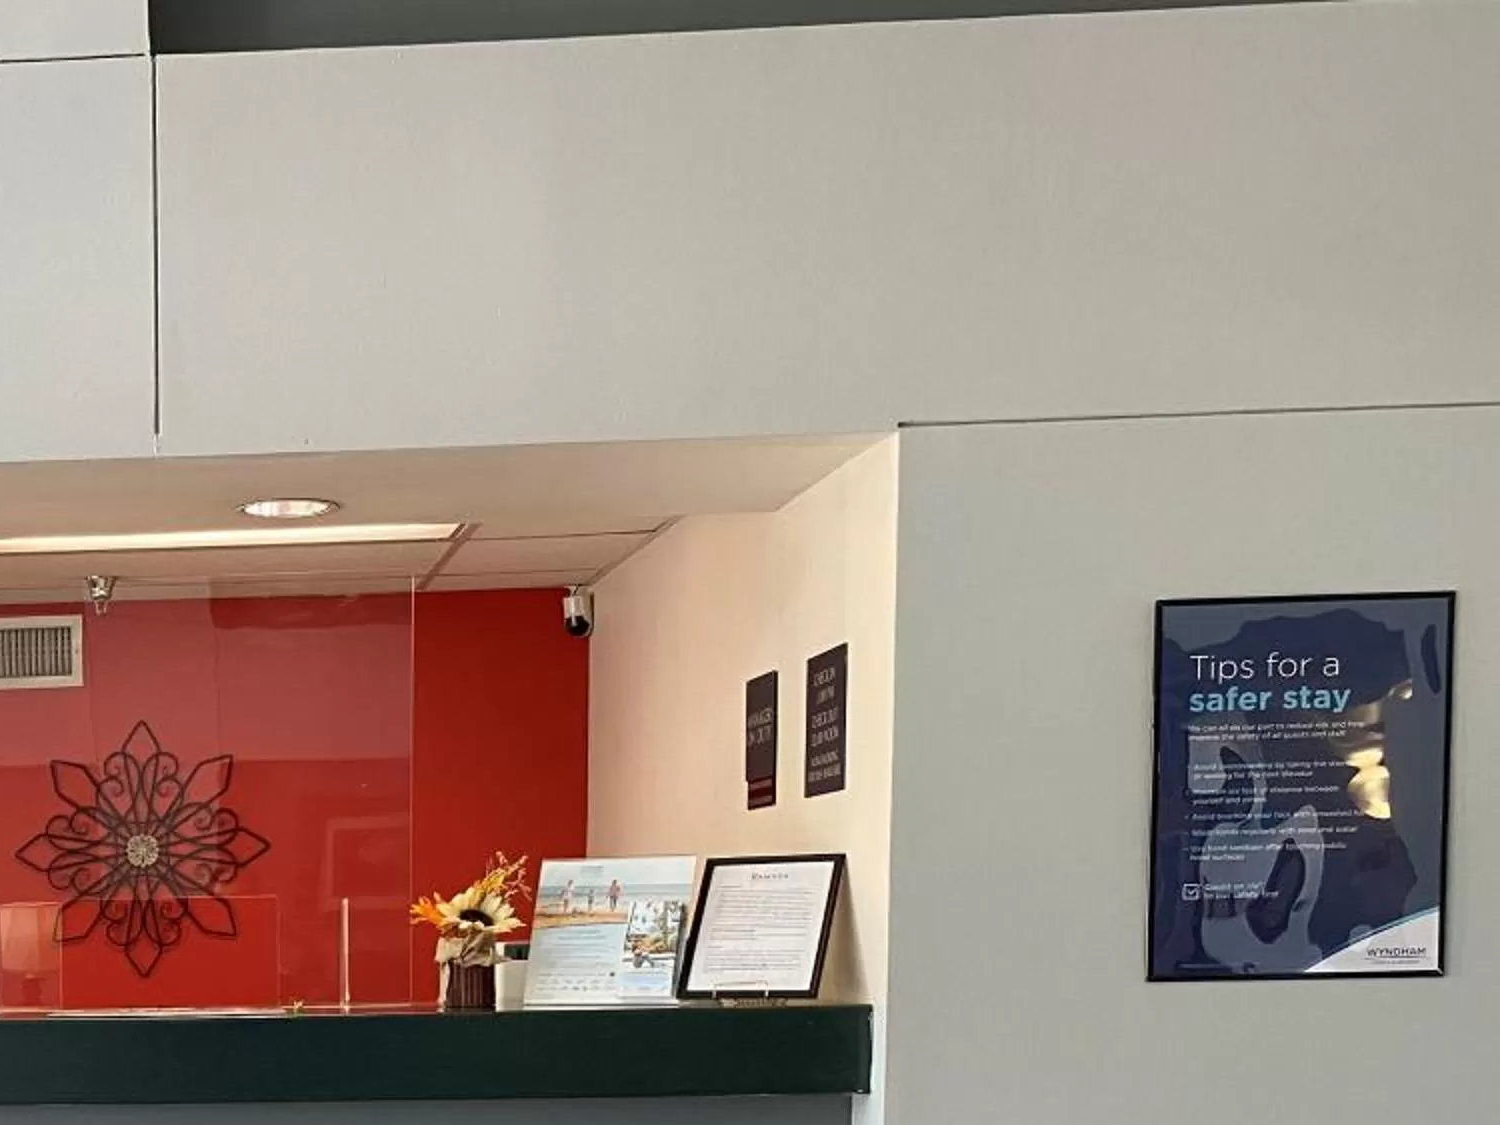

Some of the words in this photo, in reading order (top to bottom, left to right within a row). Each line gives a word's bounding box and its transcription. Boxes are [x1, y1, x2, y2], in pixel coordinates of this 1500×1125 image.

[1189, 655, 1255, 685] Tips
[1265, 651, 1313, 678] for
[1323, 657, 1340, 677] a
[1189, 686, 1273, 712] safer
[1282, 685, 1351, 713] stay
[1366, 946, 1427, 956] WYNDHAM
